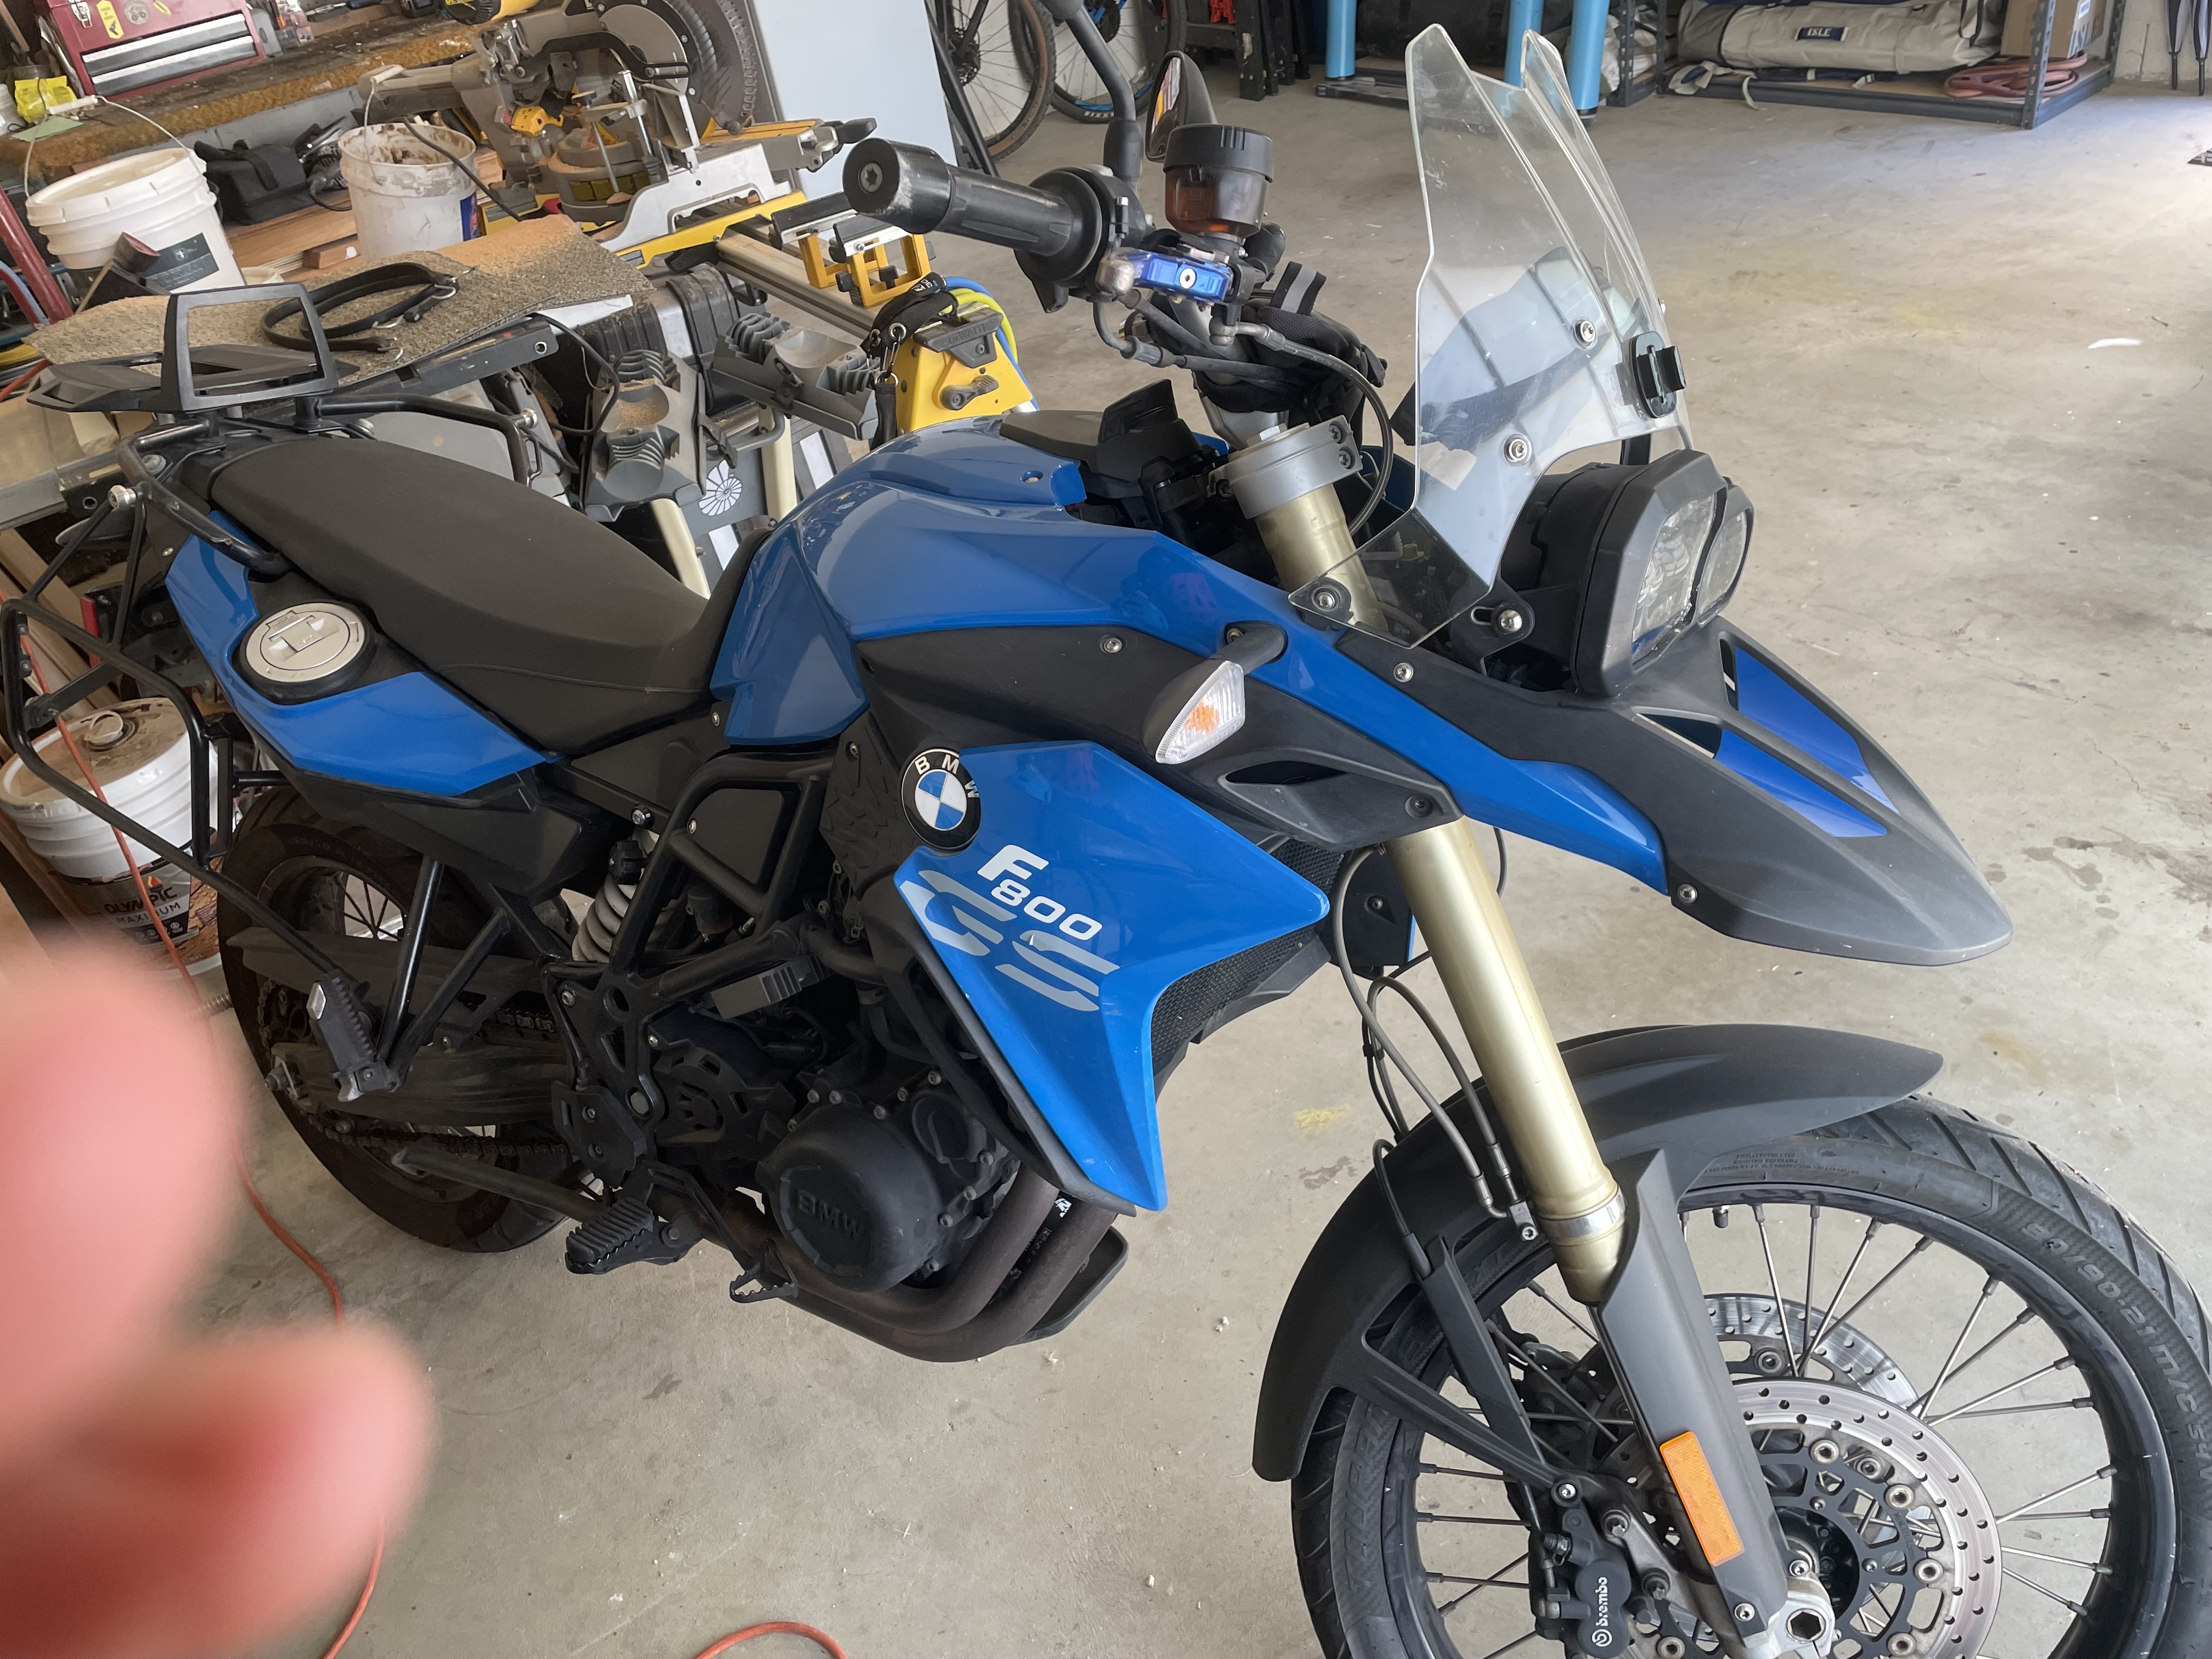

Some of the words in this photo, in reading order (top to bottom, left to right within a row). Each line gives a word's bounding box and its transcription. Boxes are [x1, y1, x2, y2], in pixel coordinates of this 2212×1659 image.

[1807, 27, 1832, 37] ISLE
[915, 754, 980, 798] BMW
[977, 844, 1049, 881] F
[116, 901, 181, 924] MAXIUM
[990, 878, 1103, 940] 800
[797, 1189, 865, 1239] BMW
[1595, 1577, 1609, 1626] brembo
